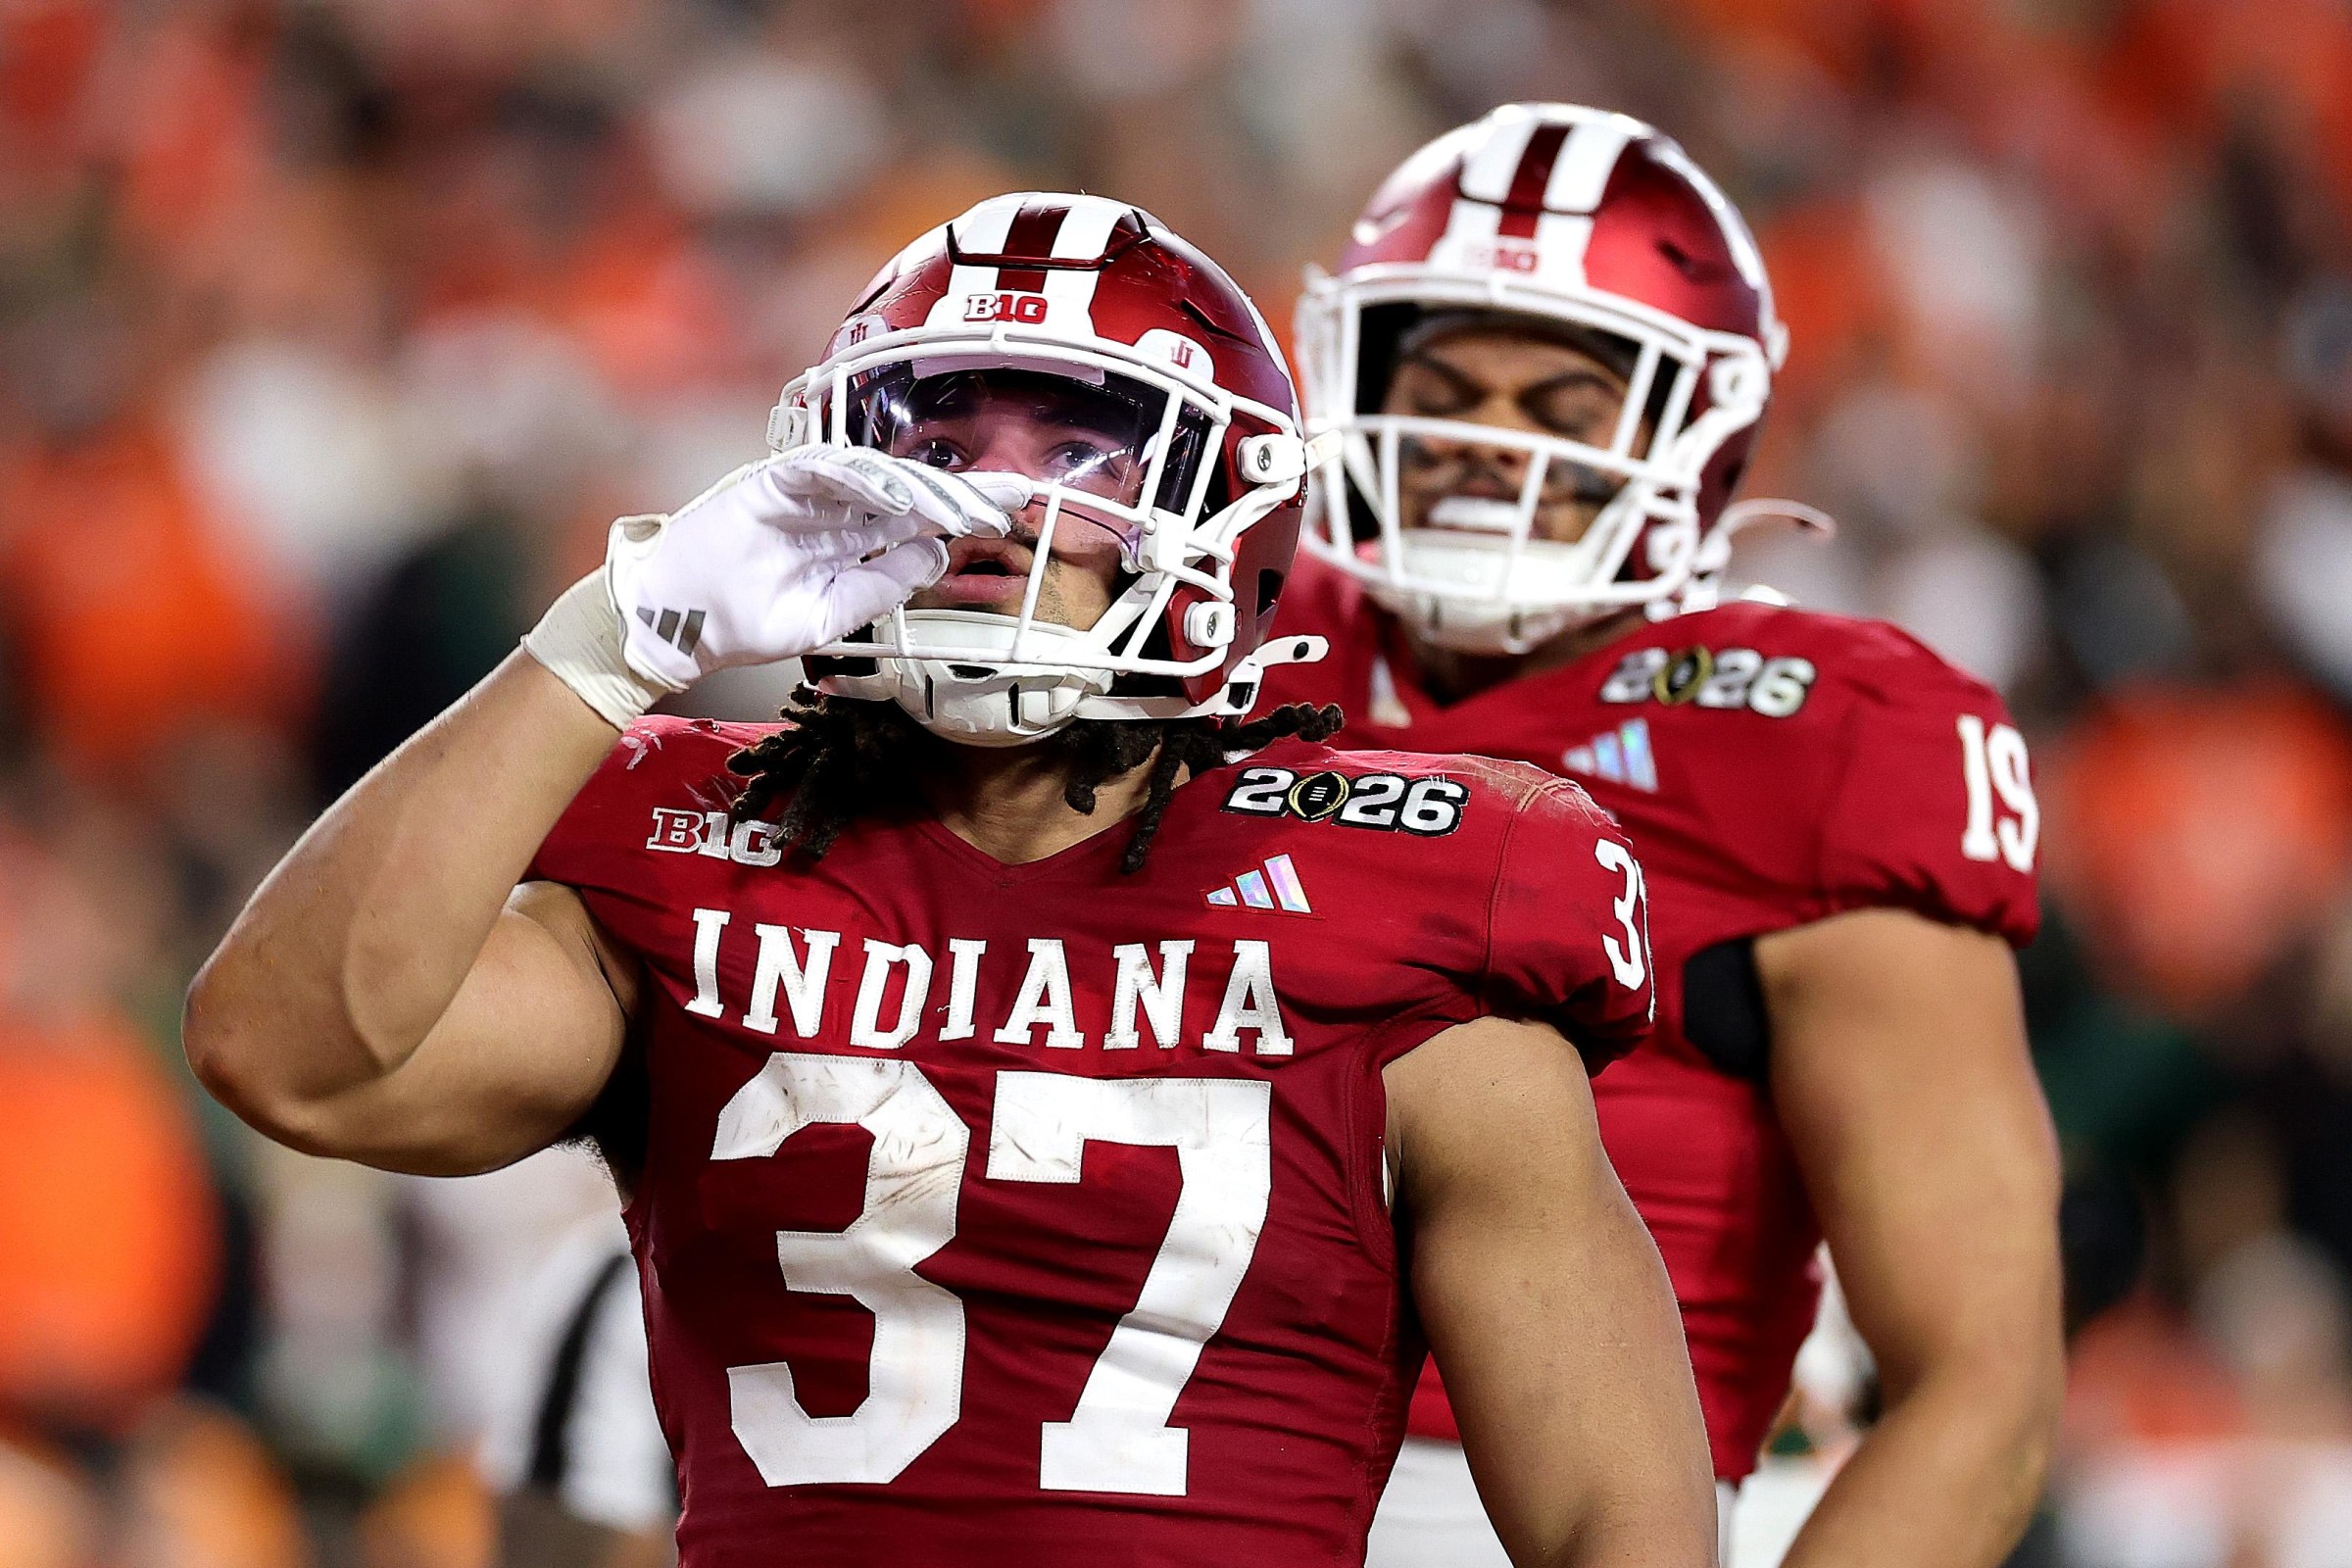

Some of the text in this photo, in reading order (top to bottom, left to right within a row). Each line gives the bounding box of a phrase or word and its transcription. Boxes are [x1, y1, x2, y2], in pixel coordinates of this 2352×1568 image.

[1956, 713, 2040, 874] 19
[685, 907, 1295, 1055] INDIANA
[1594, 838, 1656, 1024] 3
[710, 1051, 1272, 1496] 37
